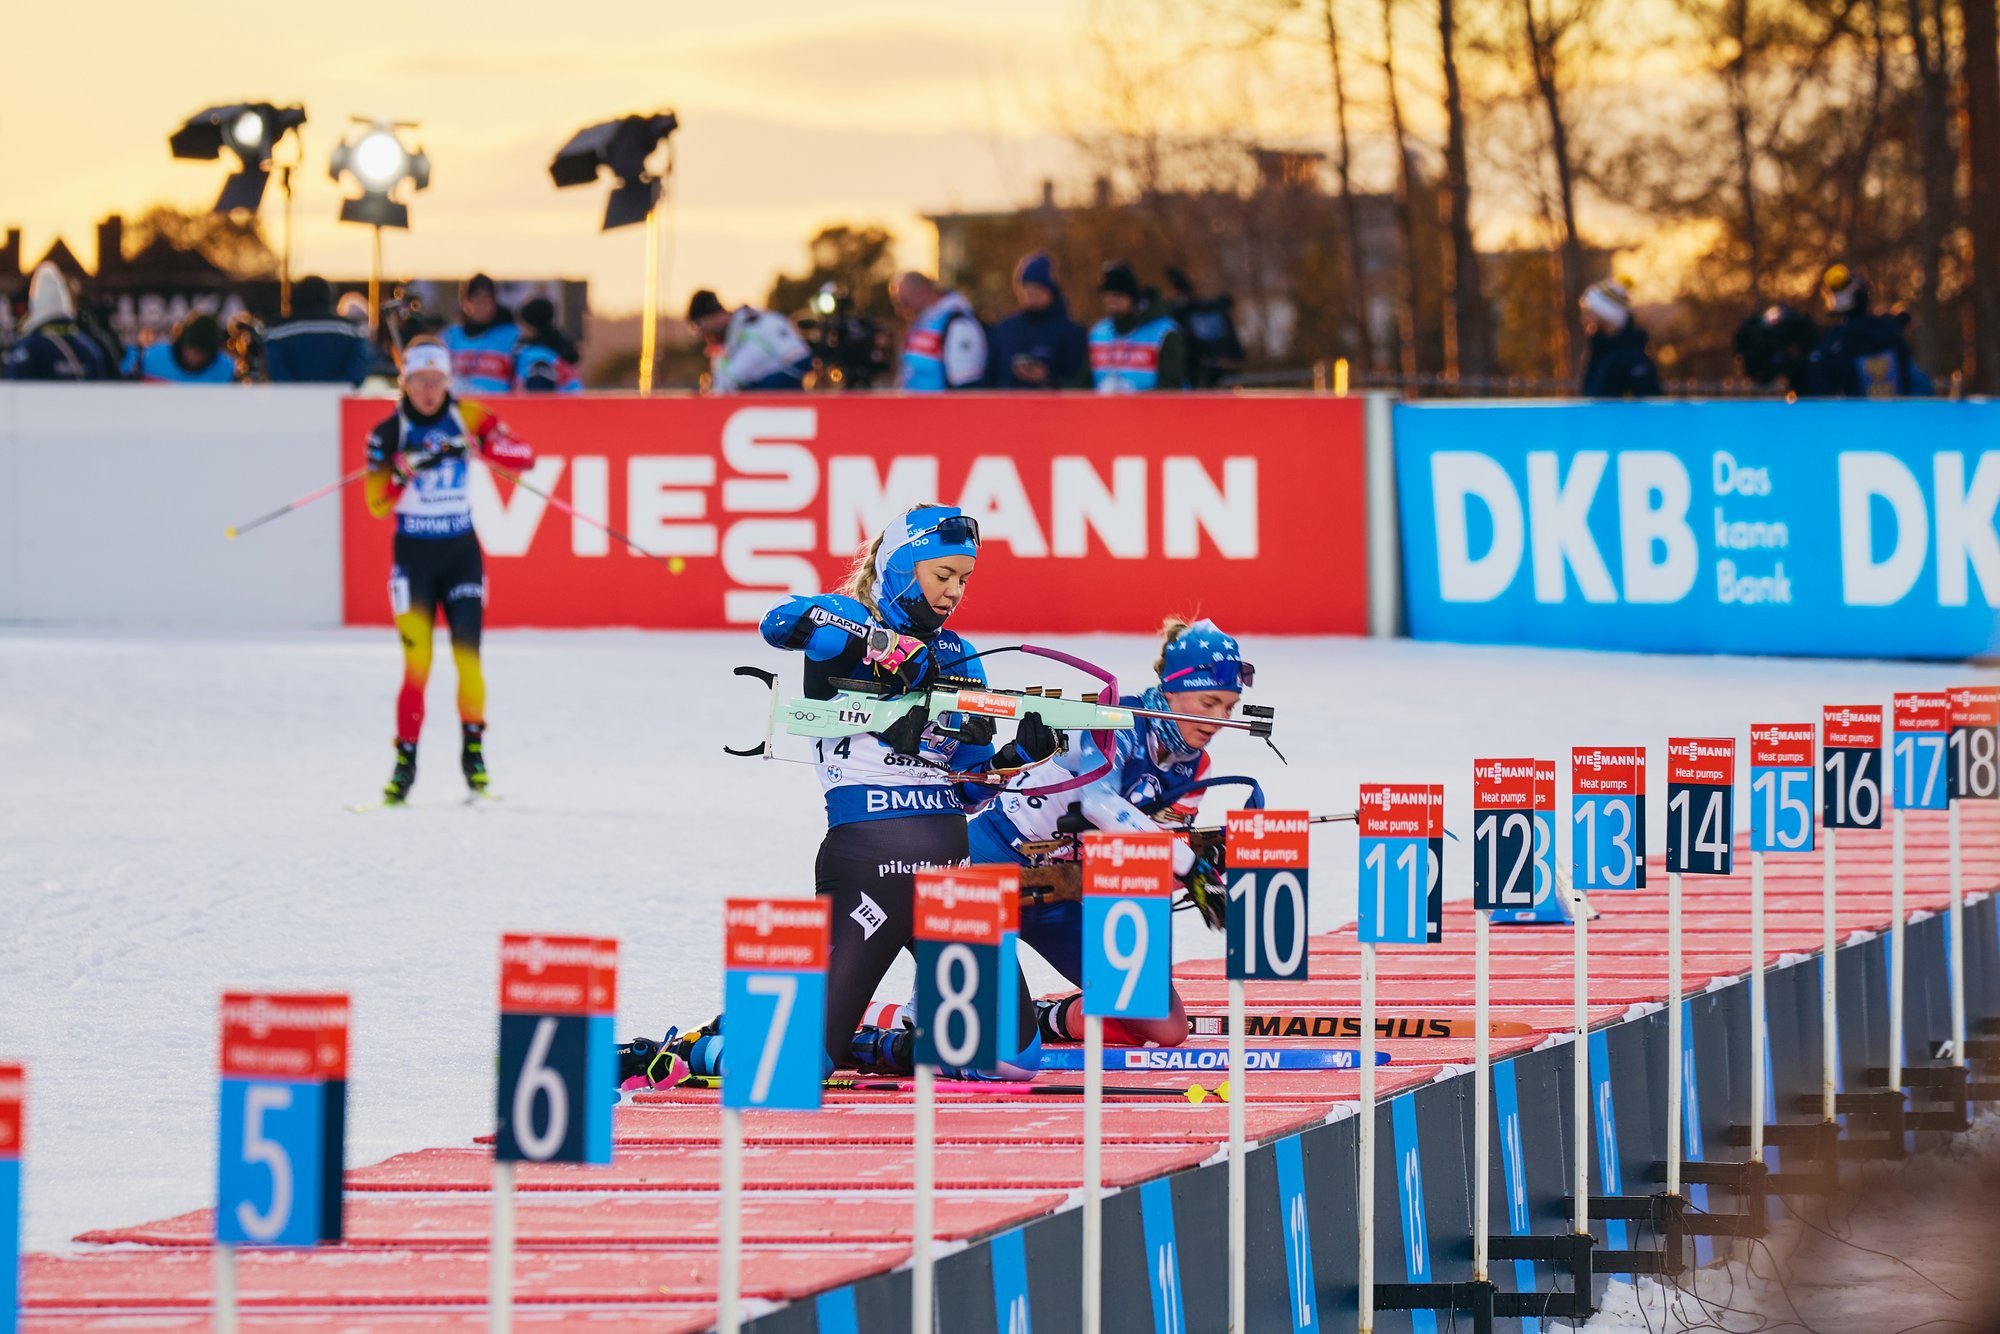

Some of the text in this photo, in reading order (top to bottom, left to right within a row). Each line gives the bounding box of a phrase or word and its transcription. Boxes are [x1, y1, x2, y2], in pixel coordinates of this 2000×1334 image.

[1713, 450, 1771, 495] Das
[468, 407, 1258, 623] VIESSMANN
[1430, 450, 1699, 603] DKB
[1715, 507, 1788, 549] kann
[1838, 450, 2000, 607] DK
[911, 538, 929, 548] 100
[1717, 560, 1791, 604] Bank
[829, 614, 864, 637] LAPUA
[938, 640, 961, 653] BMW
[960, 694, 1016, 709] VIESSMANN
[1895, 695, 1945, 712] VIESSMANN
[839, 710, 871, 724] LHV
[1824, 709, 1881, 727] VIESSMANN
[1899, 718, 1939, 728] Heat pumps
[1752, 727, 1811, 746] VIESSMANN
[1830, 733, 1874, 744] Heat pumps
[1574, 751, 1634, 771] VIESSMANN
[1669, 742, 1731, 762] VIESSMANN
[1758, 752, 1804, 763] Heat pumps
[1950, 728, 1996, 797] 18
[1475, 762, 1533, 784] VIESSMANN
[1580, 778, 1627, 790] Heat pumps
[1675, 767, 1723, 781] Heat pumps
[1894, 736, 1944, 806] 17
[866, 789, 940, 813] BMW
[1361, 788, 1427, 811] VIESSMANN
[1481, 792, 1499, 803] Heat
[1501, 793, 1526, 804] pumps
[1824, 751, 1879, 826] 16
[1752, 770, 1810, 849] 15
[1228, 814, 1308, 839] VIESSMANN
[1368, 819, 1419, 832] Heat pumps
[1669, 789, 1728, 871] 14
[1084, 838, 1170, 867] VIESSMANN
[1236, 847, 1298, 863] Heat pumps
[1574, 799, 1632, 886] 13
[1476, 813, 1532, 904] 12
[916, 877, 1000, 909] VIESSMANN
[1094, 874, 1159, 891] Heat pumps
[1365, 843, 1416, 938] 11
[858, 904, 882, 928] iizi
[1228, 871, 1306, 976] 10
[1103, 900, 1149, 1011] 9
[933, 943, 981, 1067] 8
[746, 974, 798, 1104] 7
[1249, 1016, 1452, 1038] MADSHUS
[512, 1016, 570, 1161] 6
[1600, 1080, 1616, 1194] 15
[235, 1085, 294, 1242] 5
[1508, 1112, 1525, 1232] 14
[1405, 1147, 1423, 1276] 13
[1291, 1192, 1311, 1329] 12
